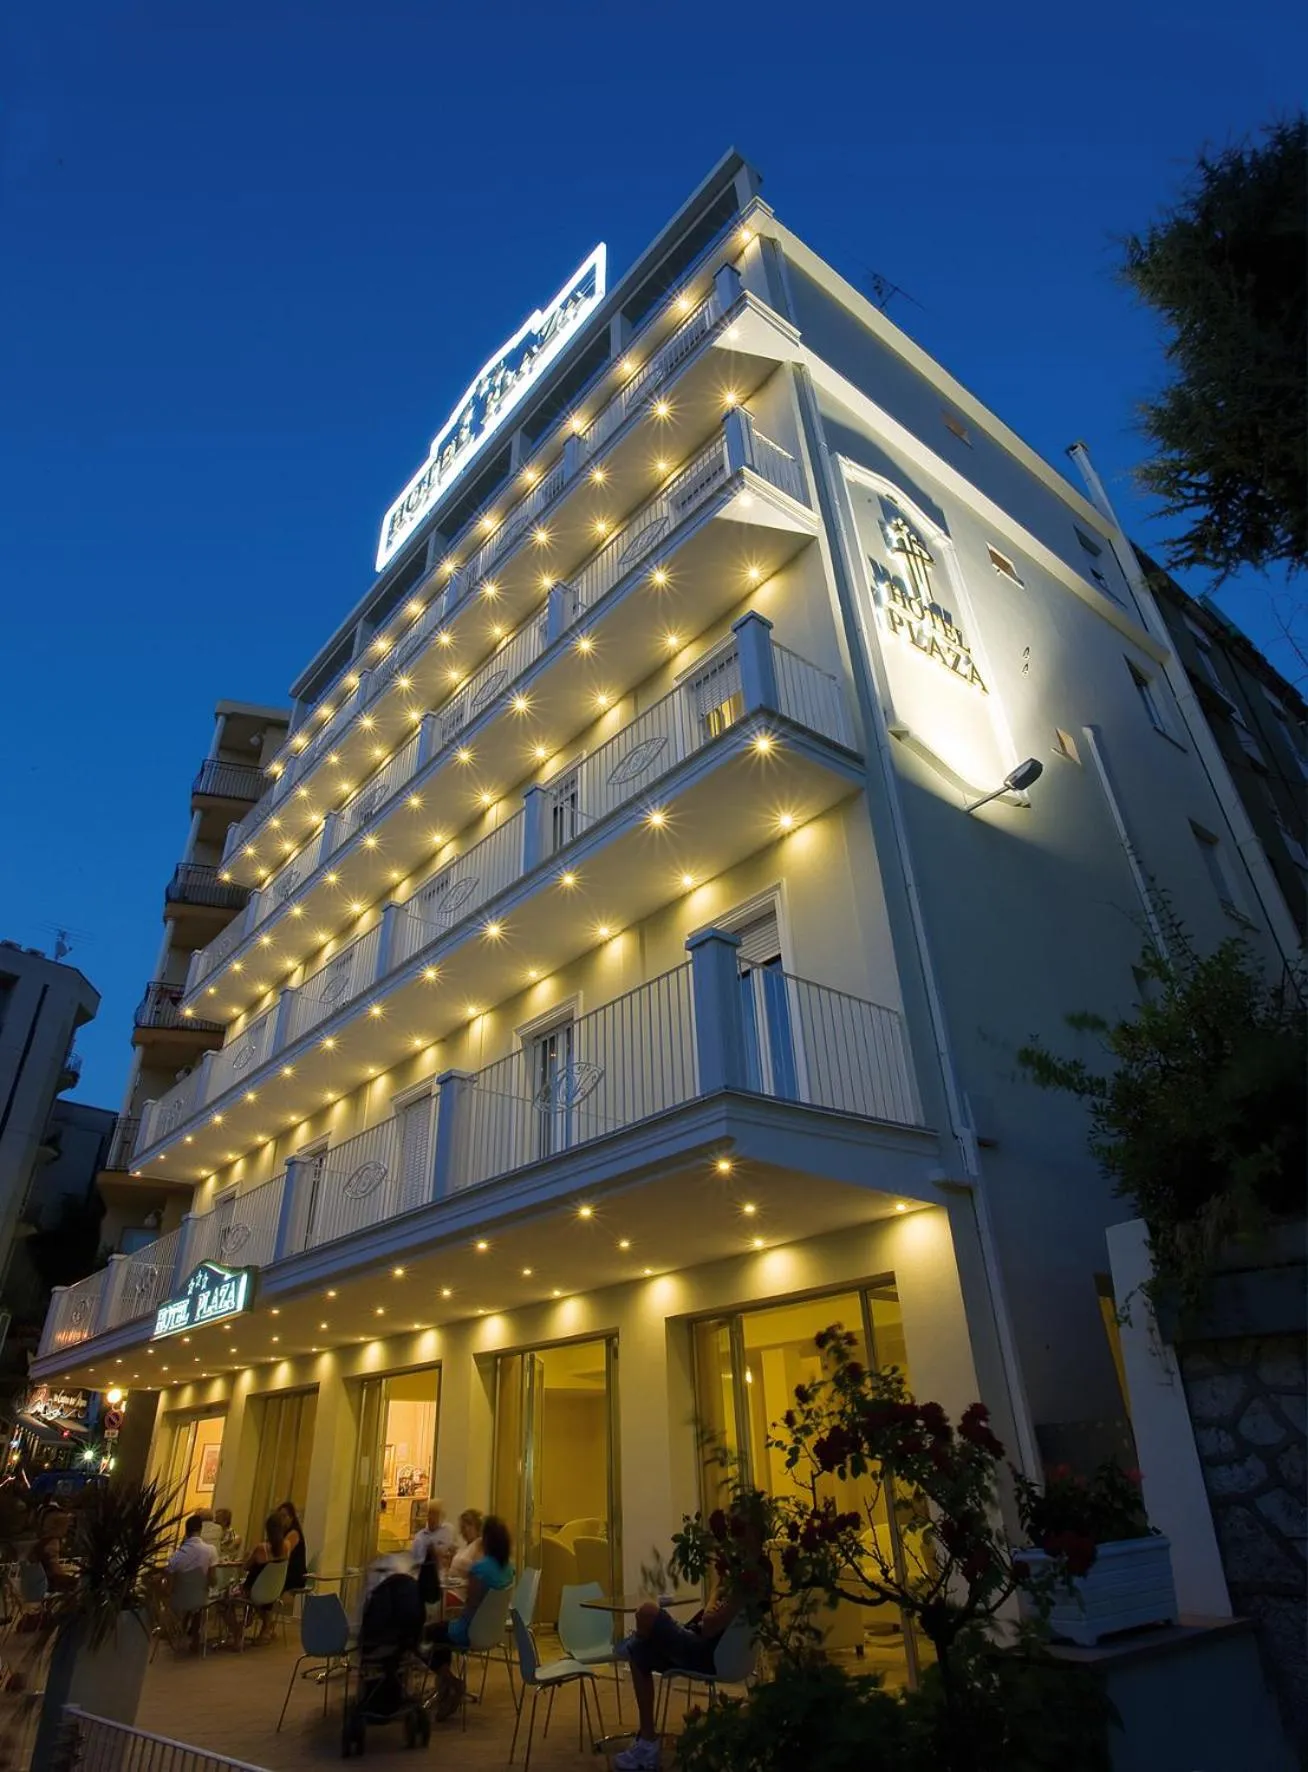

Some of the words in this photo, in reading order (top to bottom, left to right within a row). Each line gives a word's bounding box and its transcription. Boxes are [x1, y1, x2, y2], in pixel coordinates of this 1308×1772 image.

[886, 580, 970, 654] HOTEL
[887, 606, 989, 695] PLAZA
[153, 1300, 190, 1335] HOTEL
[194, 1281, 235, 1321] PLAZA
